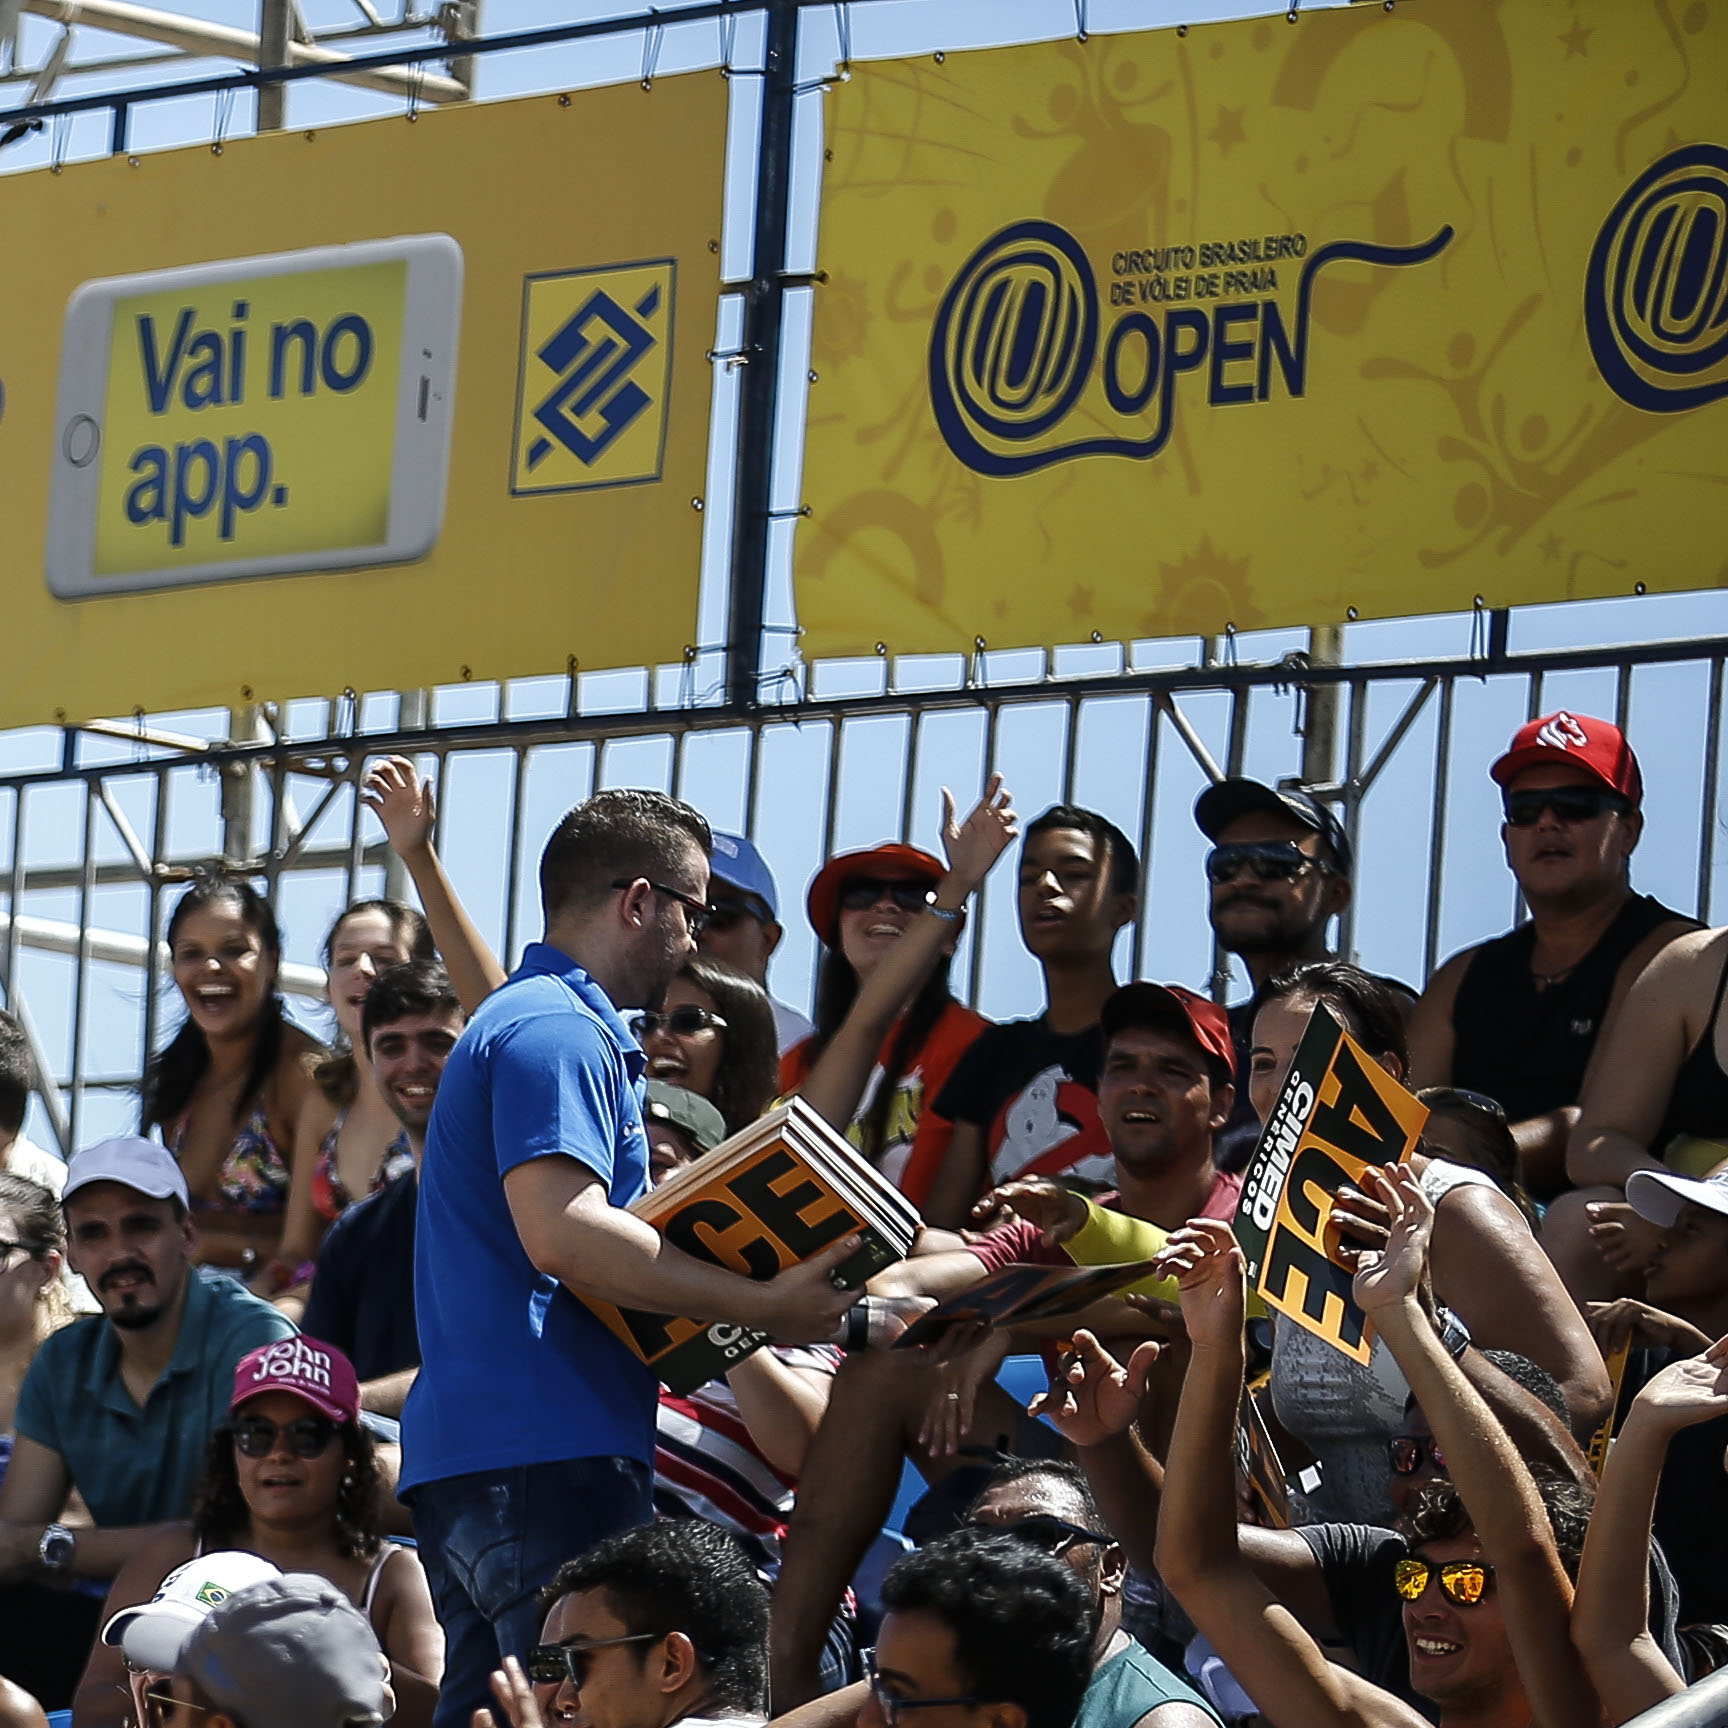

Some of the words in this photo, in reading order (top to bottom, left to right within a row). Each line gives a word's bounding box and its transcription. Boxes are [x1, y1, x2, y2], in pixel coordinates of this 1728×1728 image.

[1110, 280, 1136, 306] DE
[1194, 273, 1220, 299] DE
[1222, 265, 1279, 294] PRAIA
[1111, 244, 1196, 277] CIRCUITO
[1198, 232, 1308, 269] BRASILEIRO
[136, 300, 249, 414] Vai
[268, 310, 373, 398] no
[1103, 299, 1310, 417] OPEN
[124, 428, 288, 546] app.
[1241, 1070, 1301, 1217] GENÉRICOS
[1253, 1080, 1314, 1232] CIMED
[1265, 1037, 1410, 1349] ACE
